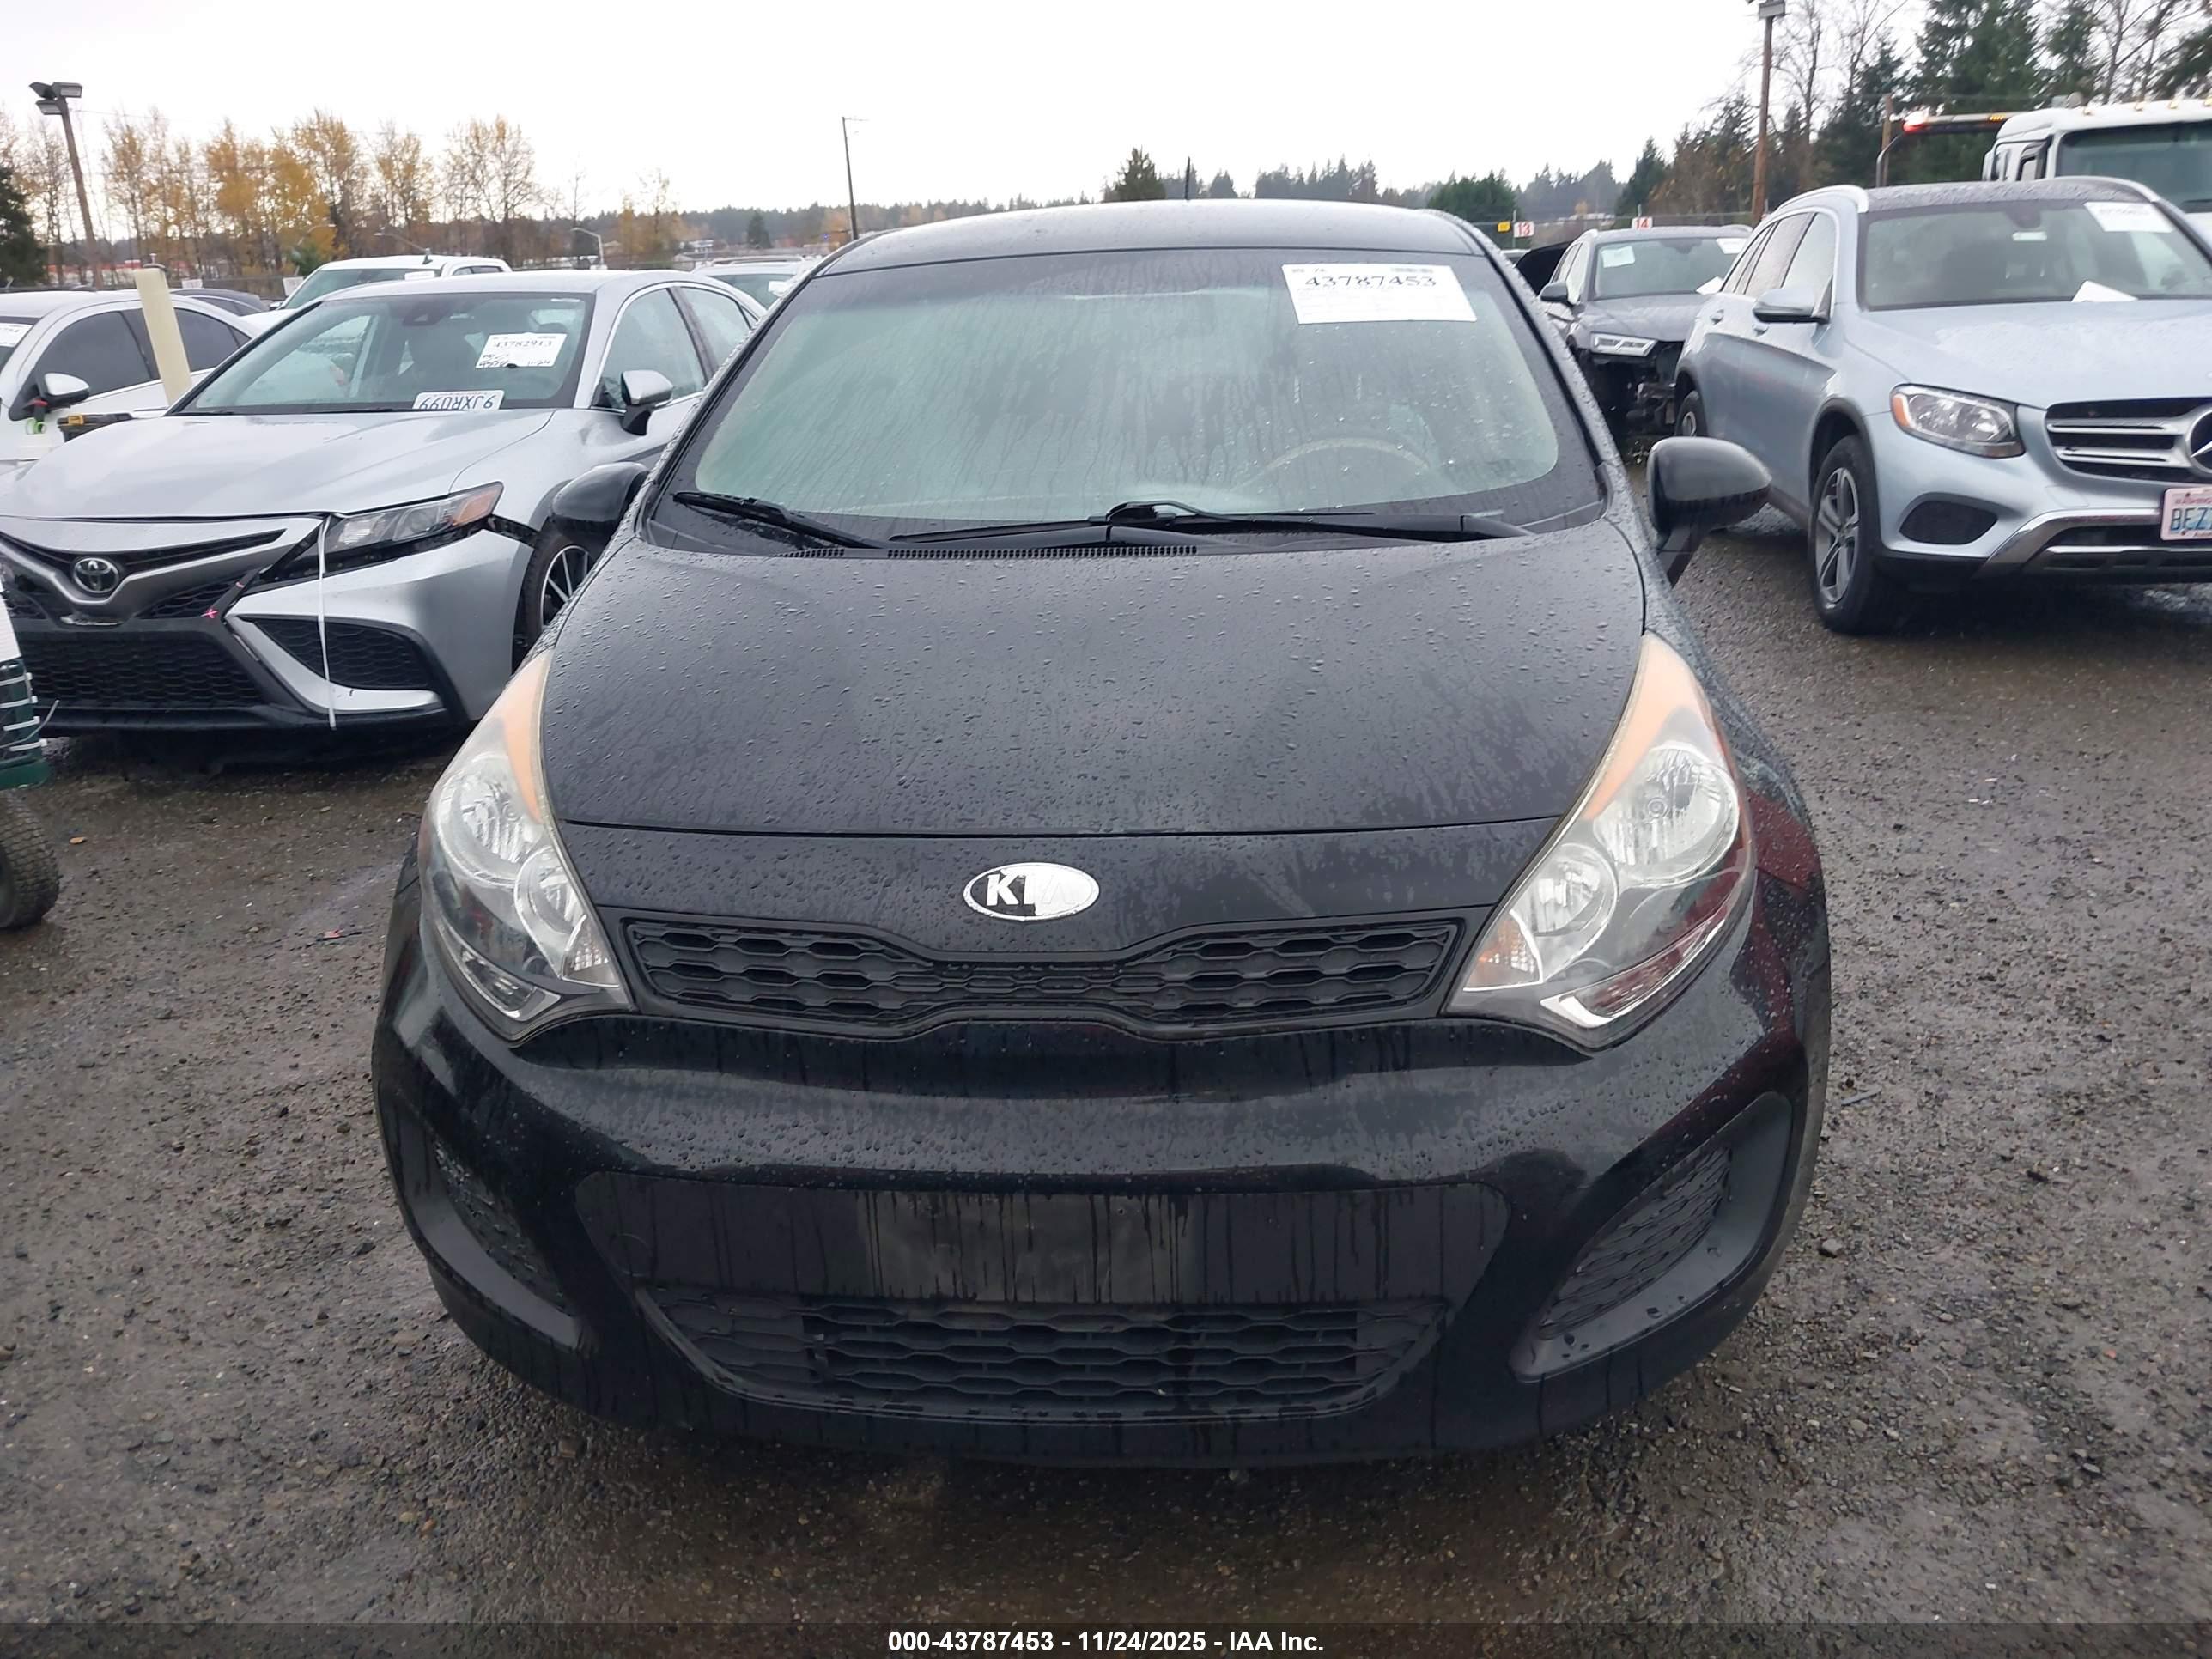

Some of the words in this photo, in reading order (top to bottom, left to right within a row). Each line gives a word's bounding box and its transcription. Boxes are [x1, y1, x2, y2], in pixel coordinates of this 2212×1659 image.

[1518, 221, 1530, 235] 13
[1636, 218, 1650, 228] 14
[1304, 275, 1437, 287] 43787453
[2171, 507, 2212, 530] BEZ
